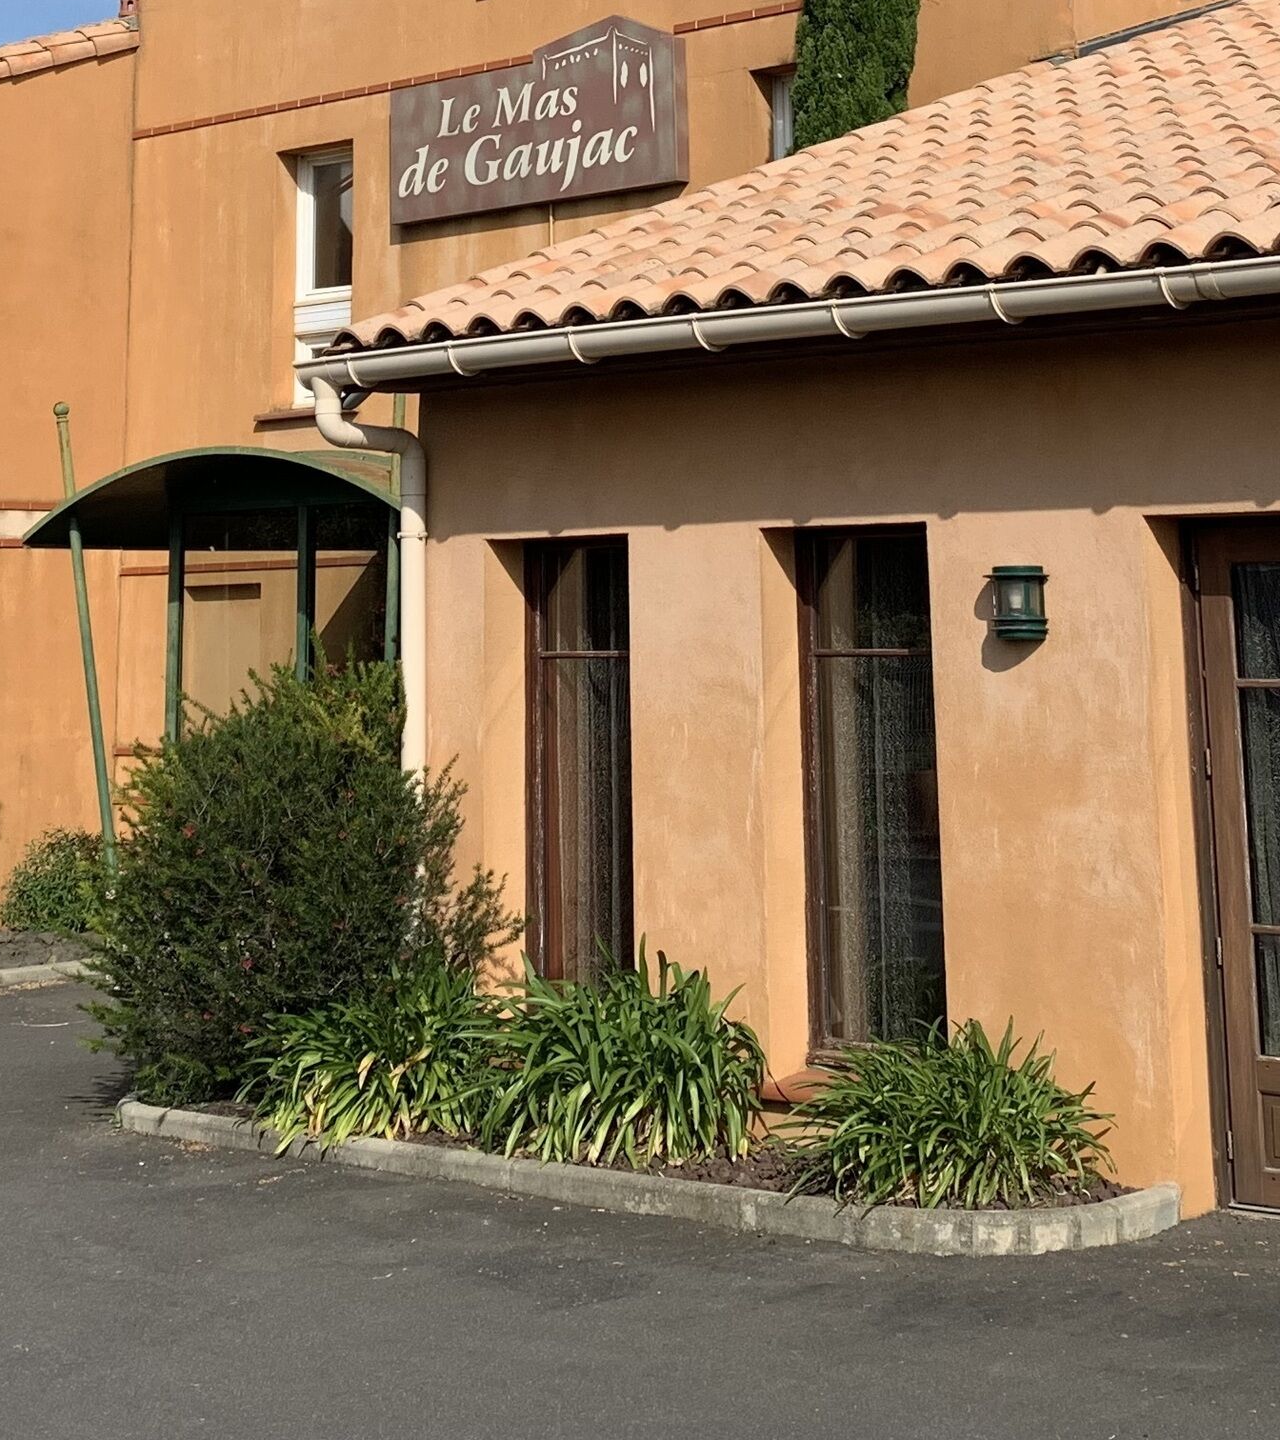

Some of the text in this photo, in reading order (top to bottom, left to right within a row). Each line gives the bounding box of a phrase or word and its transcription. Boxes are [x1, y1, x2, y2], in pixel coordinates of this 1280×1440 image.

[436, 81, 578, 138] Le Mas
[398, 119, 638, 198] de Gaujac
